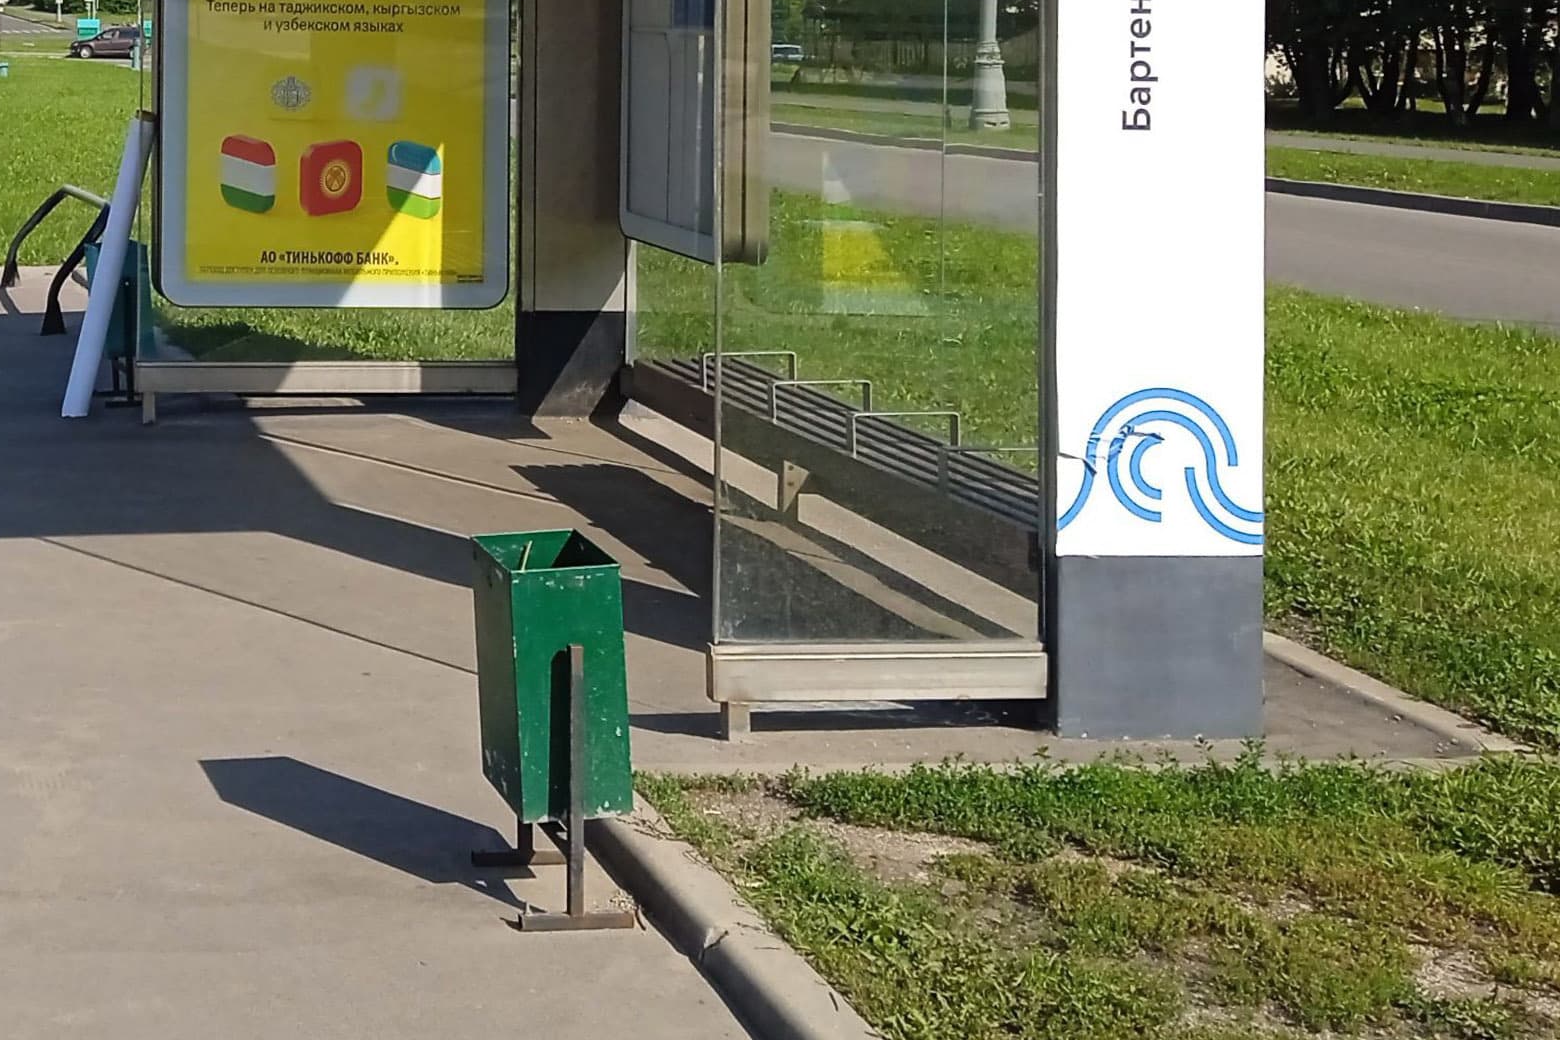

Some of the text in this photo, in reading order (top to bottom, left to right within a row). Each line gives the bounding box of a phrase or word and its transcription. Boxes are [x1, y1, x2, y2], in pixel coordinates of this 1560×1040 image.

[207, 0, 461, 18] Теперь на таджикском, кыргызском
[263, 18, 404, 34] и узбекском языках
[260, 249, 400, 265] АО «ТИНЬКОФФ БАНК».
